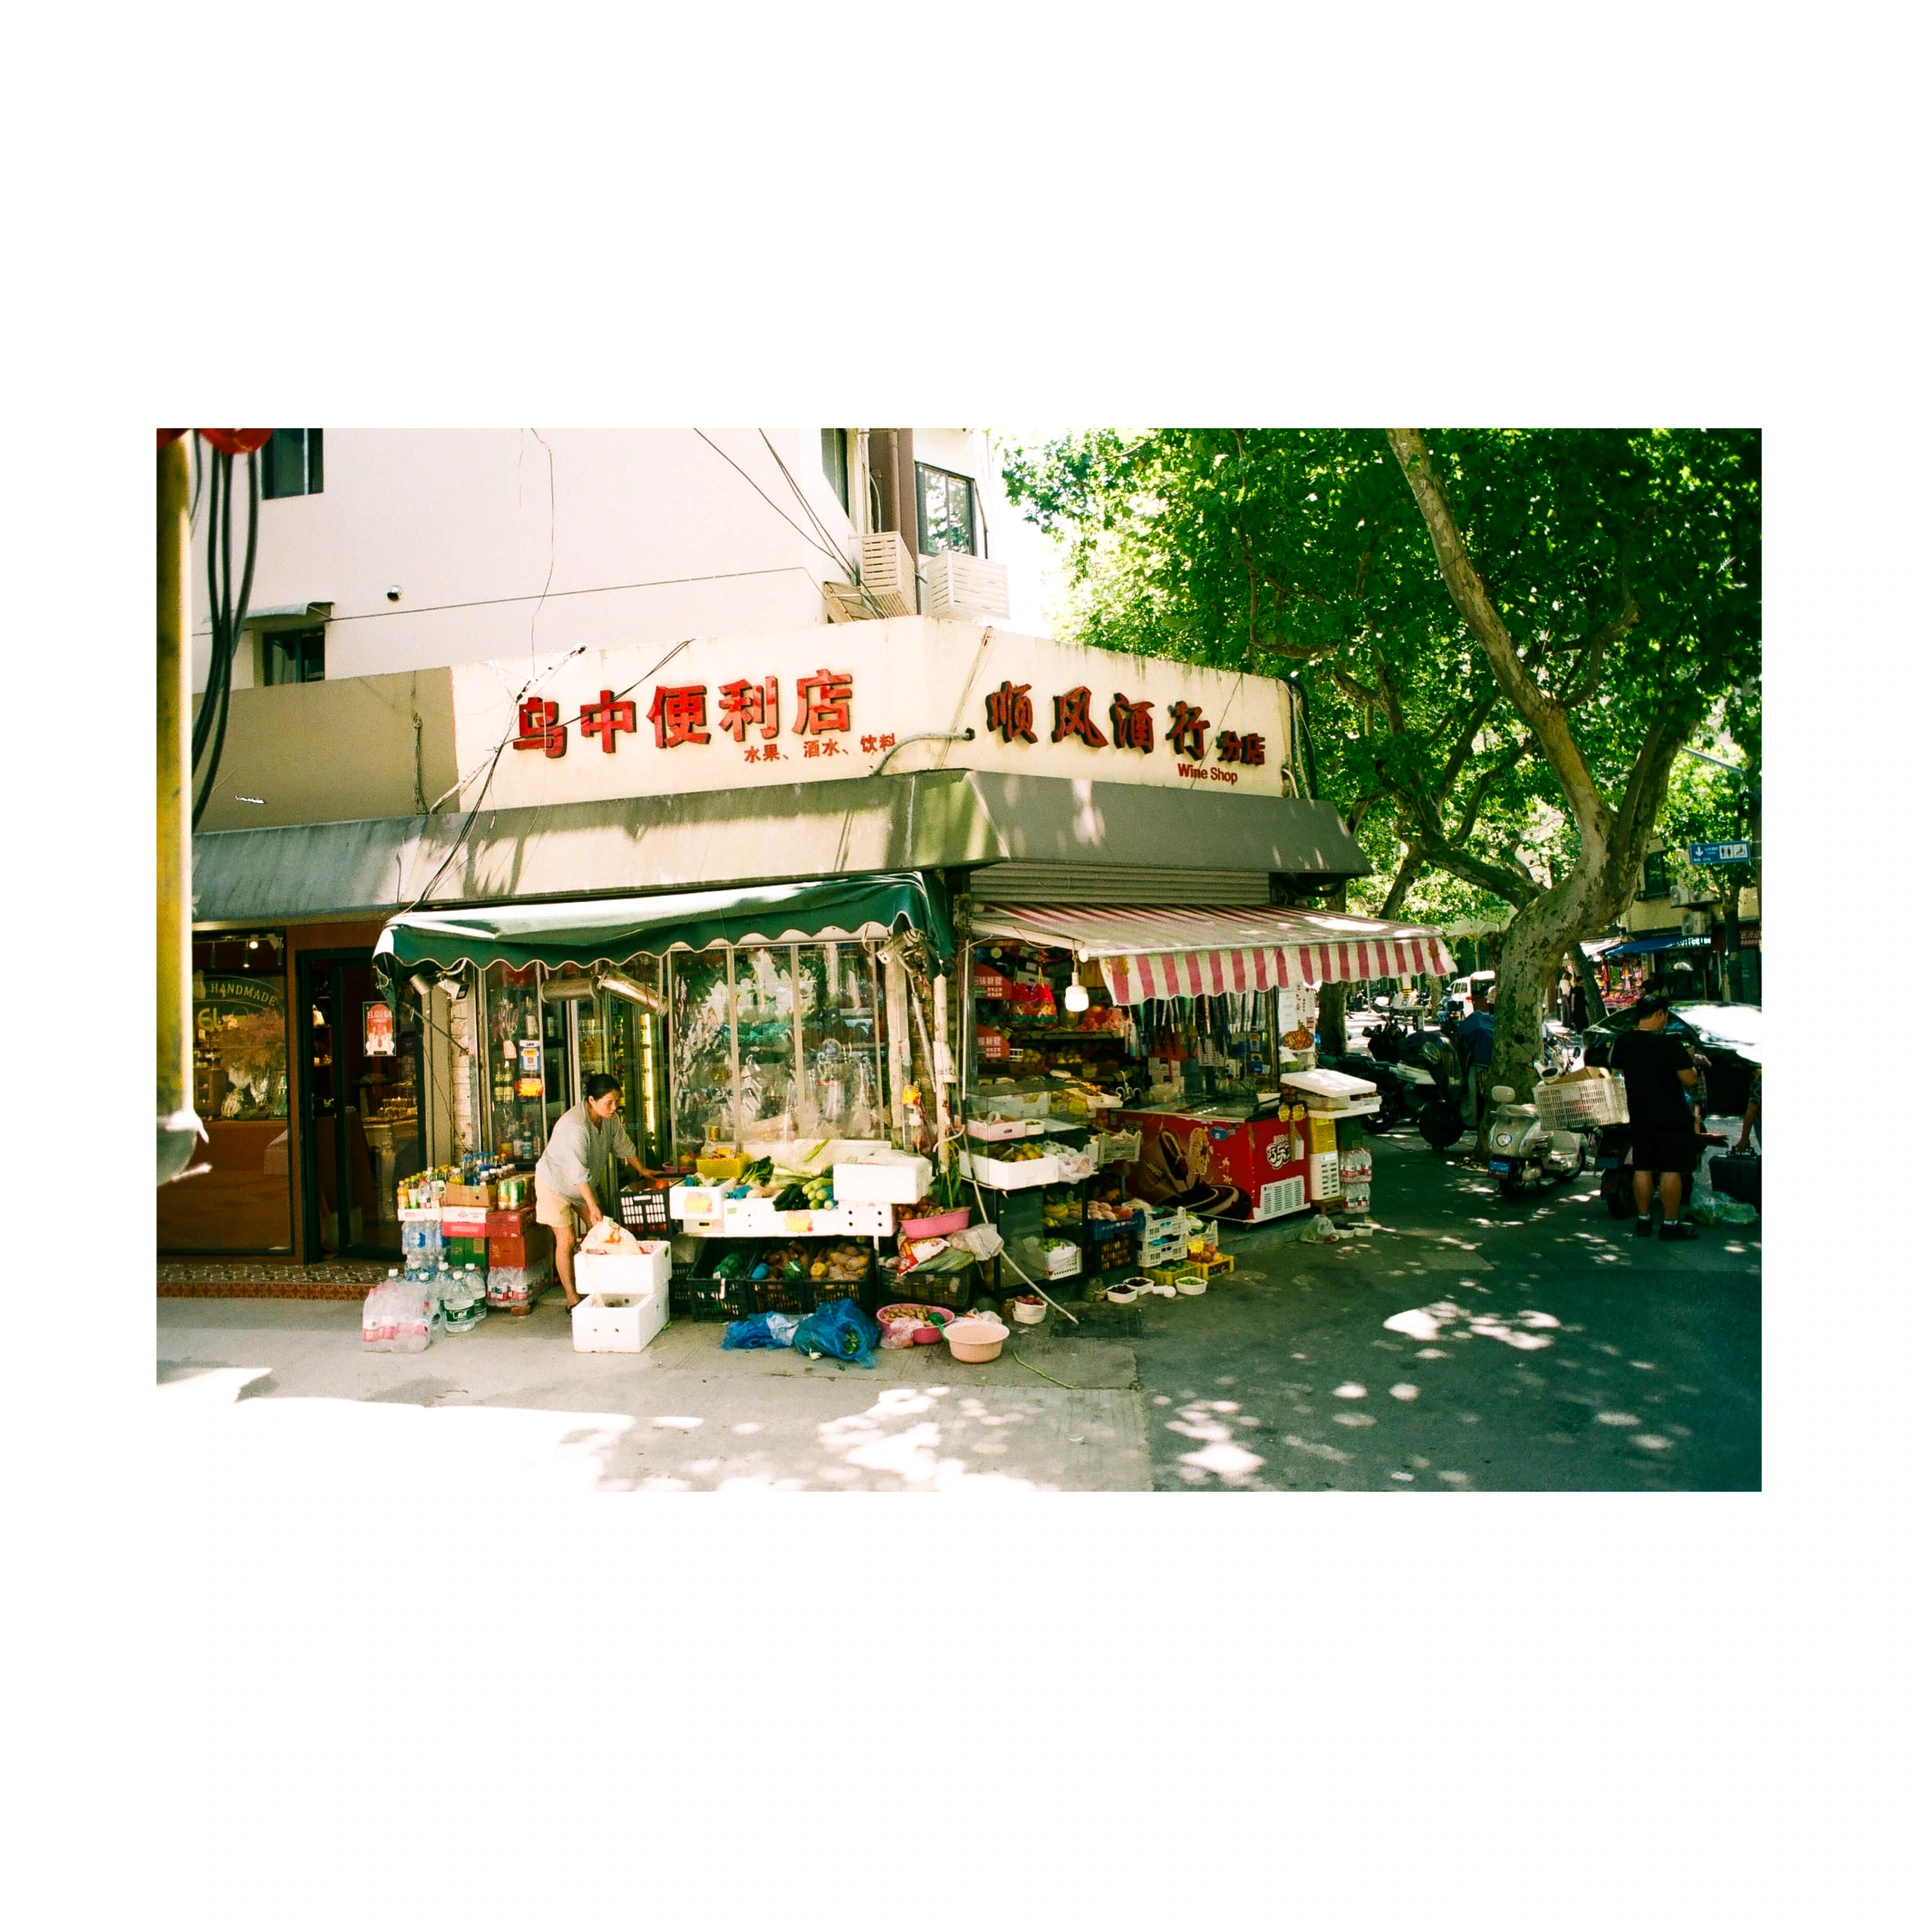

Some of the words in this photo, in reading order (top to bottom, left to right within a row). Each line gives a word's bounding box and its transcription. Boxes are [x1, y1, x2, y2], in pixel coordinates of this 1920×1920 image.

[513, 668, 853, 759] 乌中便利店
[1177, 763, 1208, 780] Wine
[1210, 767, 1238, 785] Shop
[210, 983, 278, 1007] HANDMADE
